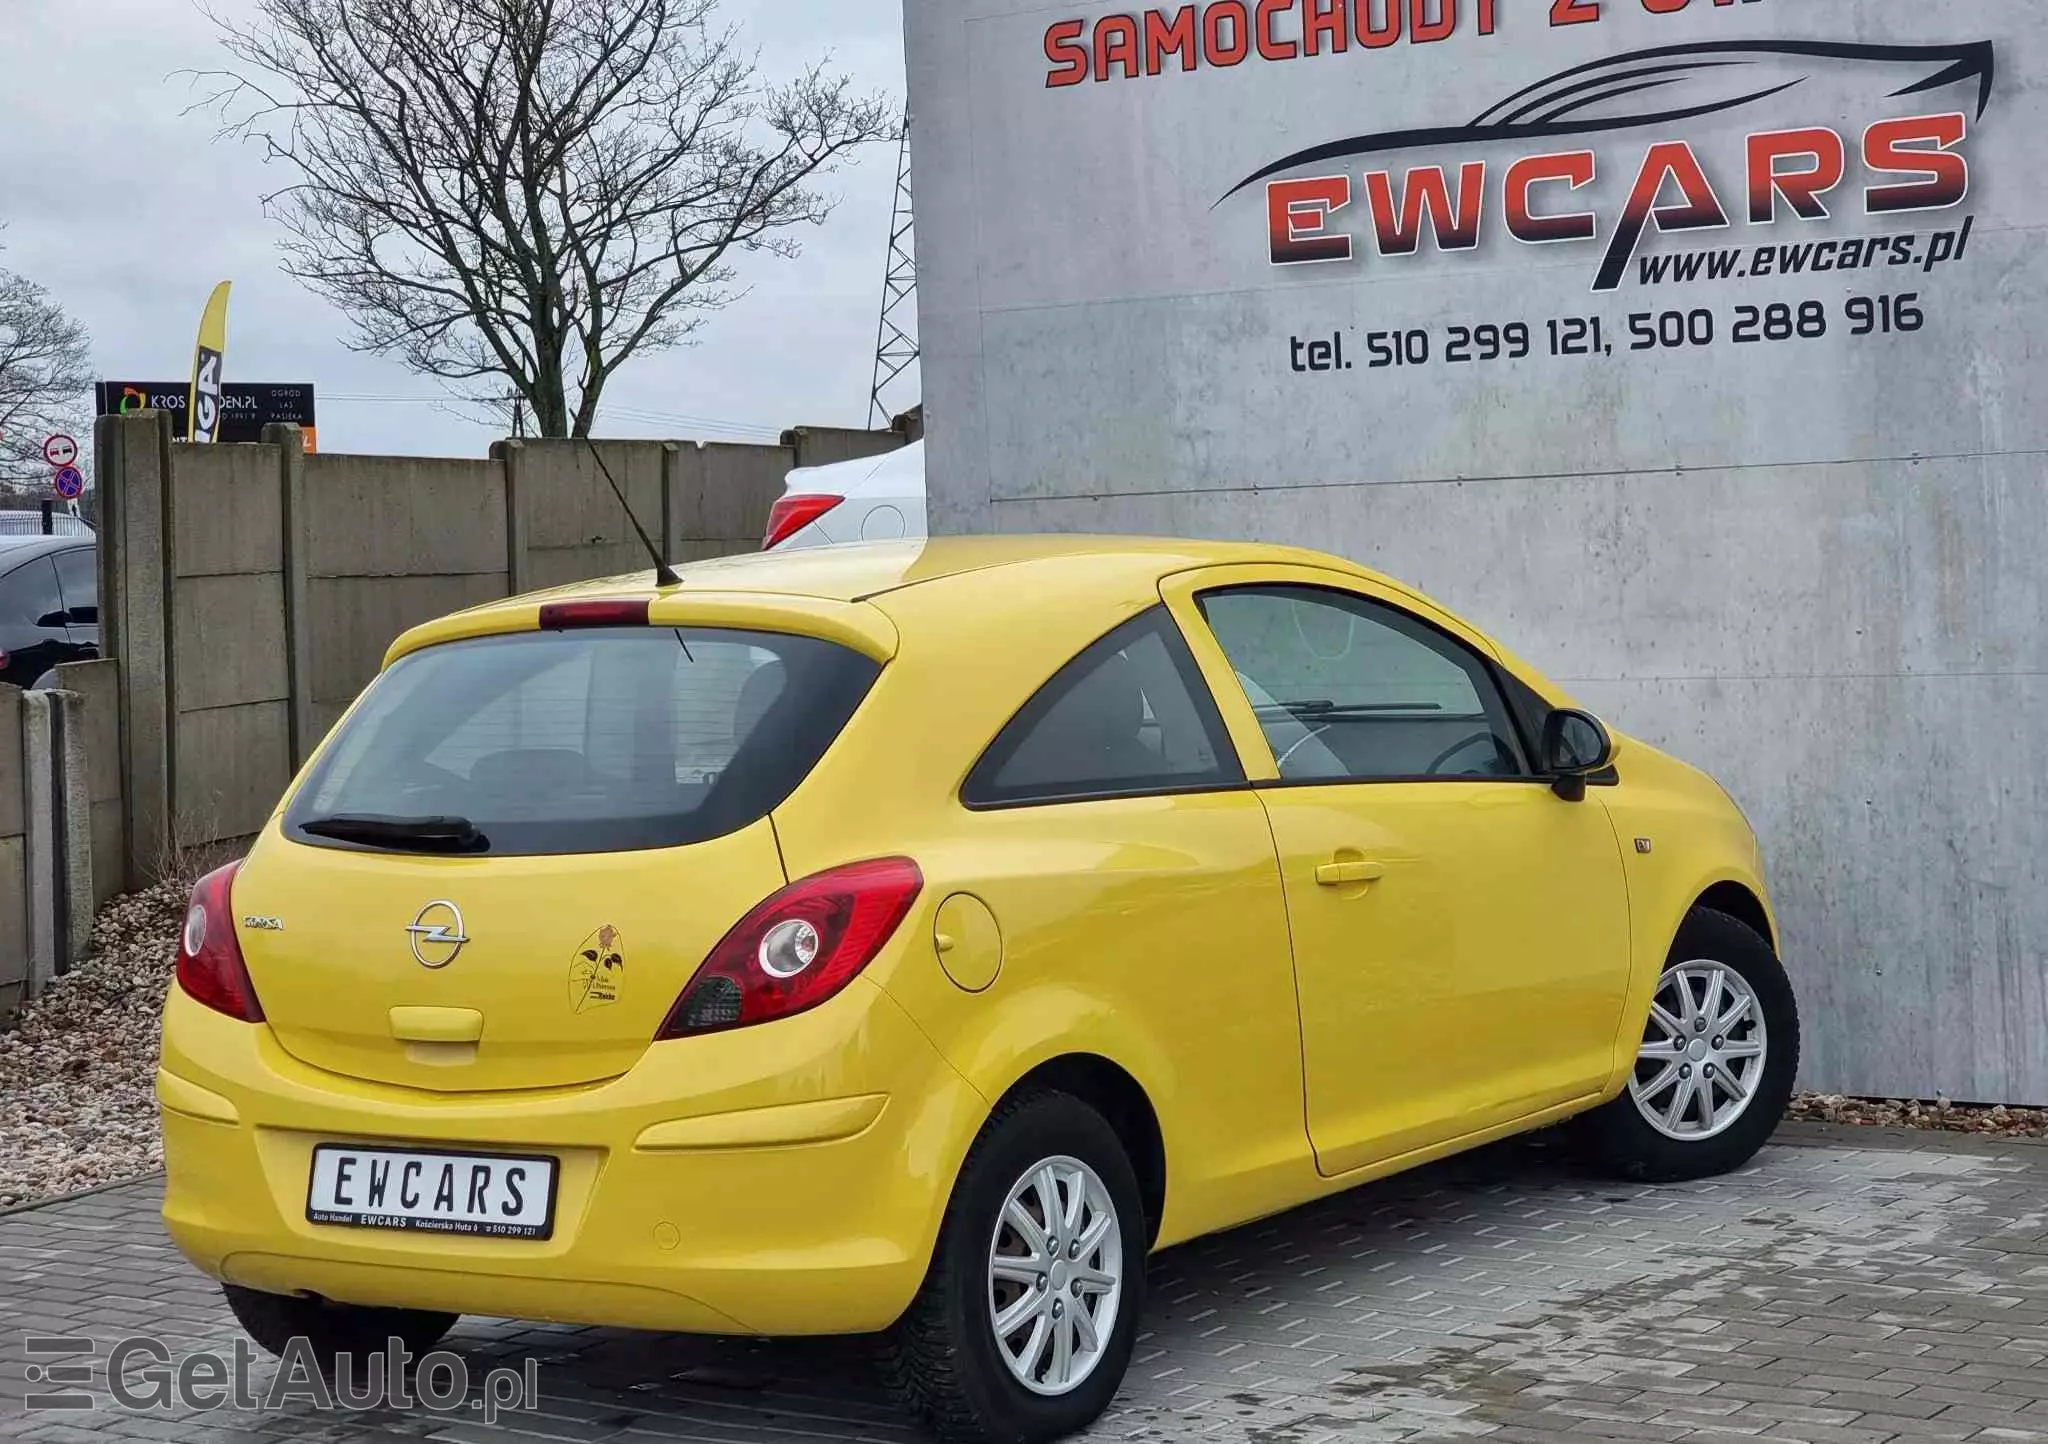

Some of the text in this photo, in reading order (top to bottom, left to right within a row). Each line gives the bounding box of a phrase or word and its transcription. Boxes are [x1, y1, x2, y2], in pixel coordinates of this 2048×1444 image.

[1266, 112, 1968, 292] EWCARS
[1638, 214, 1975, 286] www.ewcars.pl
[1289, 292, 1924, 373] tel. 510 299 121, 500 288 916
[333, 1156, 527, 1217] EWCARS
[360, 1214, 407, 1228] EWCARS
